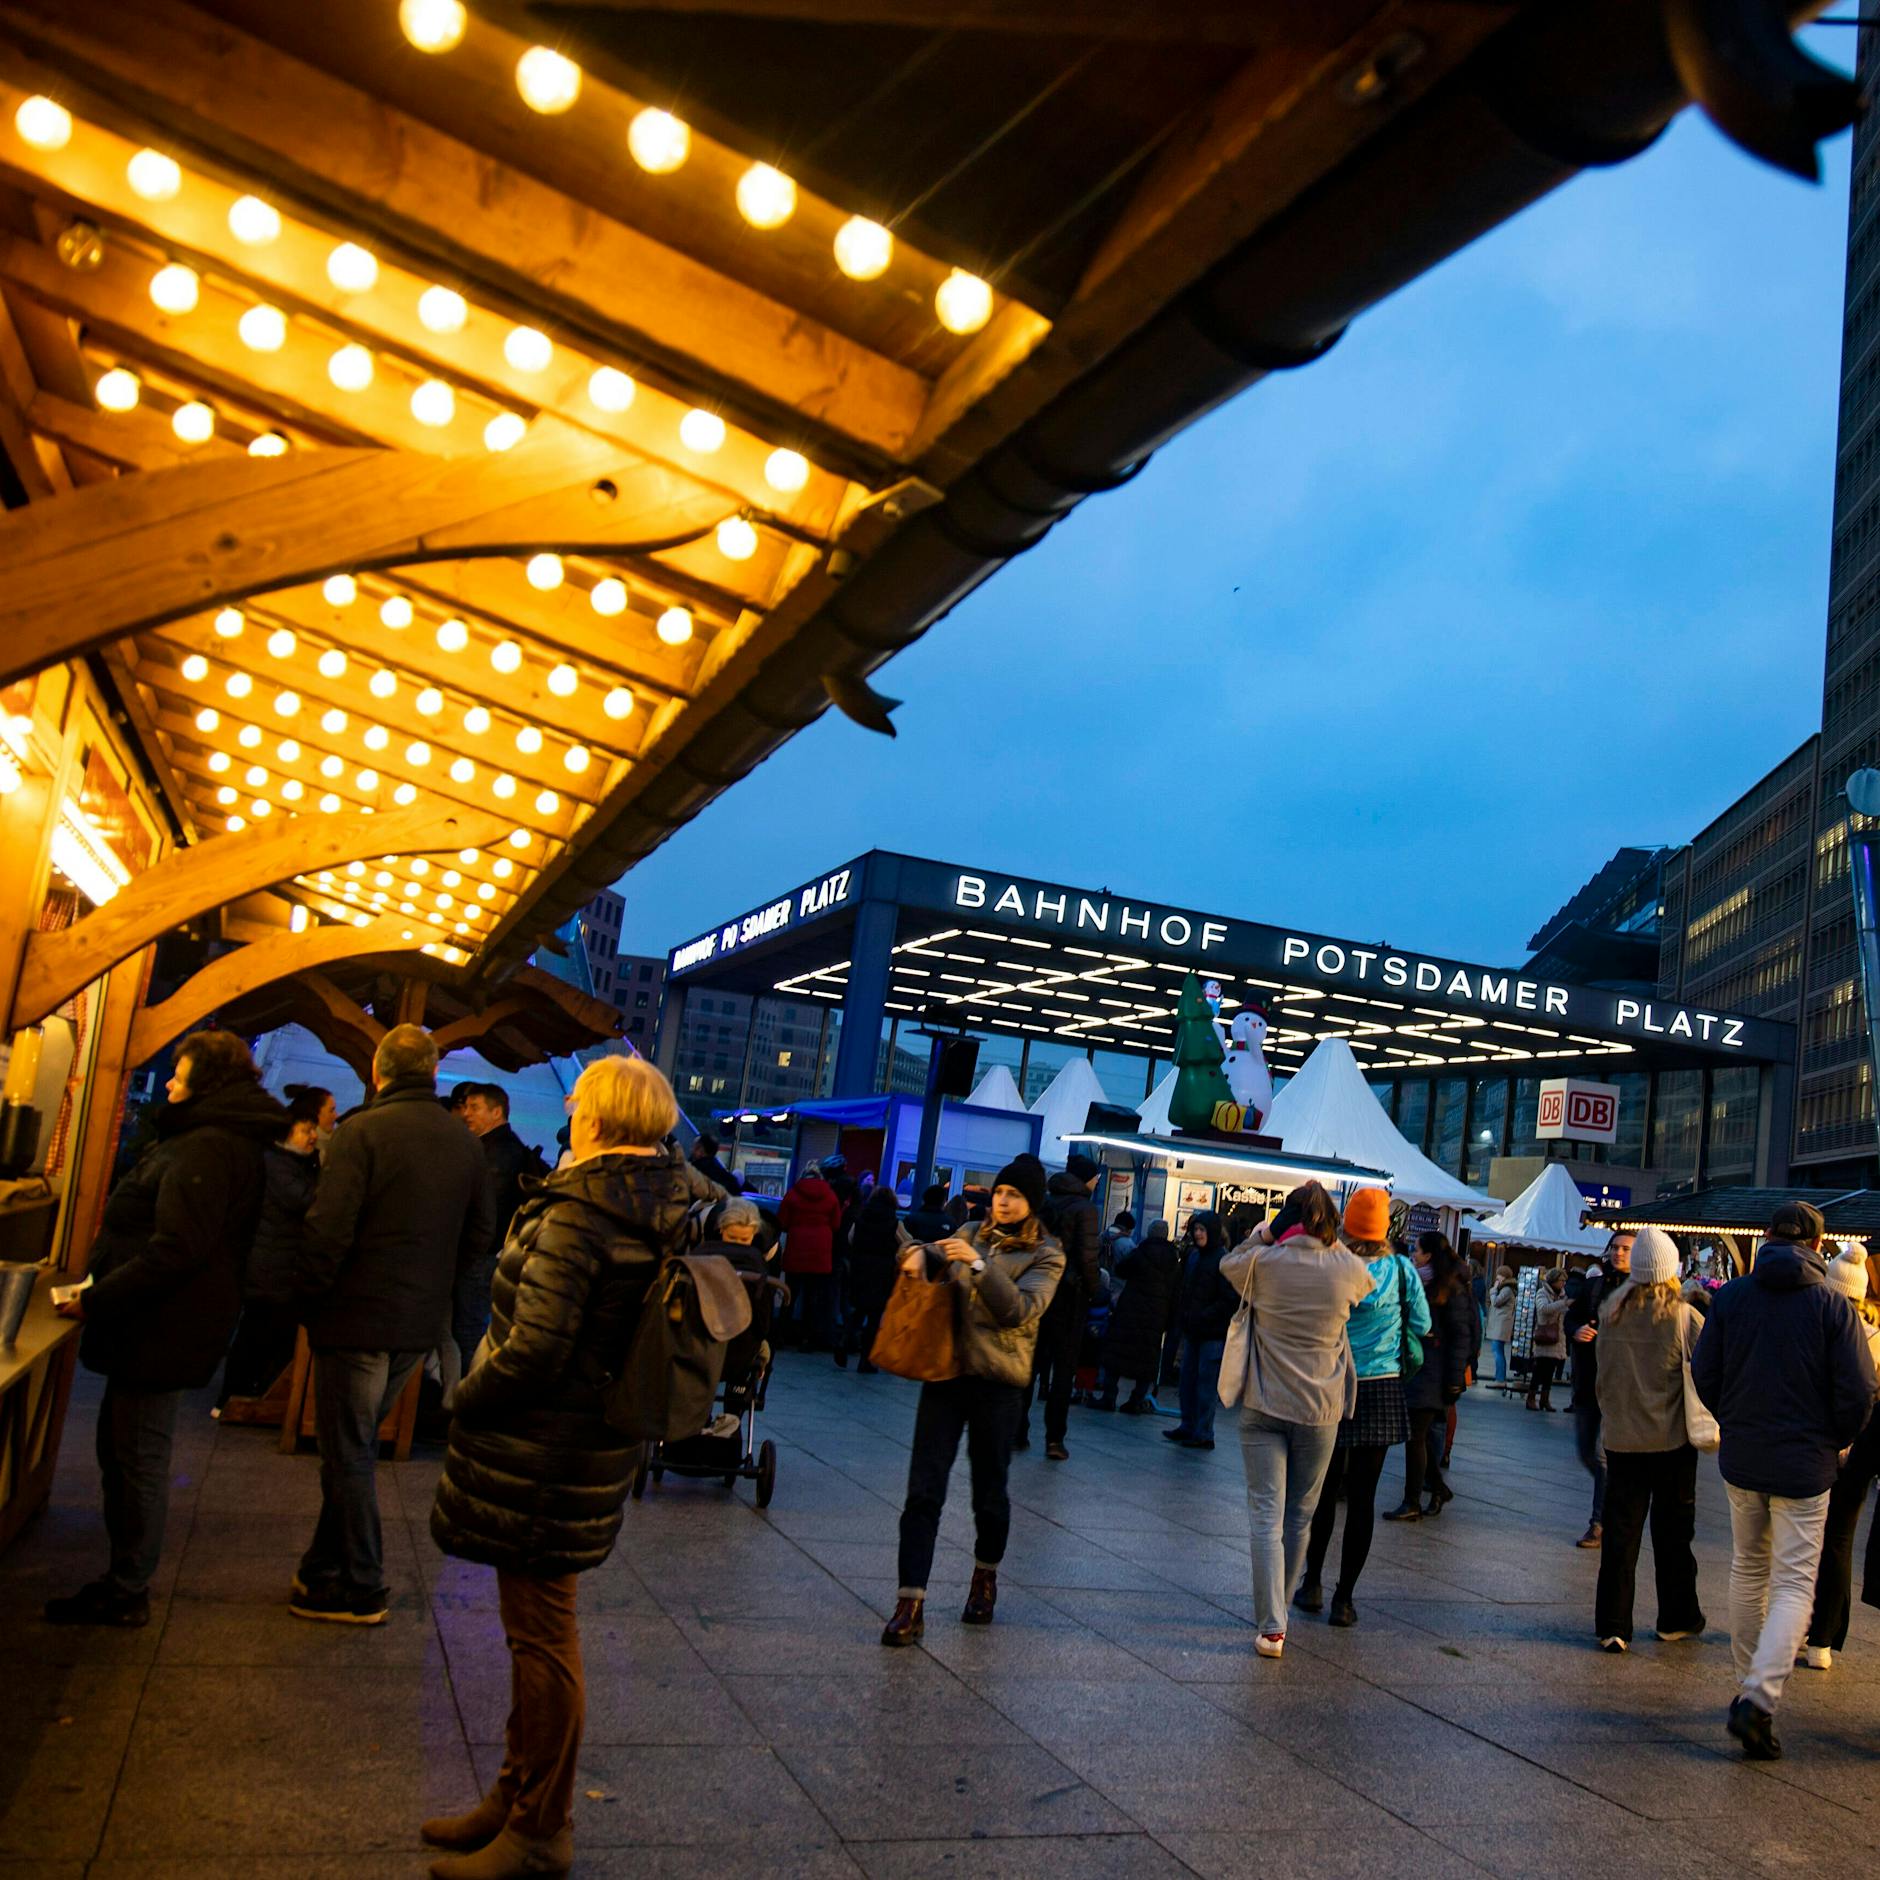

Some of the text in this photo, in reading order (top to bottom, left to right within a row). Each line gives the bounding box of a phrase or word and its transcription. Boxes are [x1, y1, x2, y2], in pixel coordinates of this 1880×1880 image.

[672, 933, 717, 972] BAHNHOF
[800, 870, 850, 917] PLATZ
[955, 874, 1744, 1047] BAHNHOF POTSDAMER PLATZ
[1542, 1097, 1561, 1121] DB
[1573, 1097, 1608, 1125] DB
[1221, 1185, 1265, 1205] Kasse
